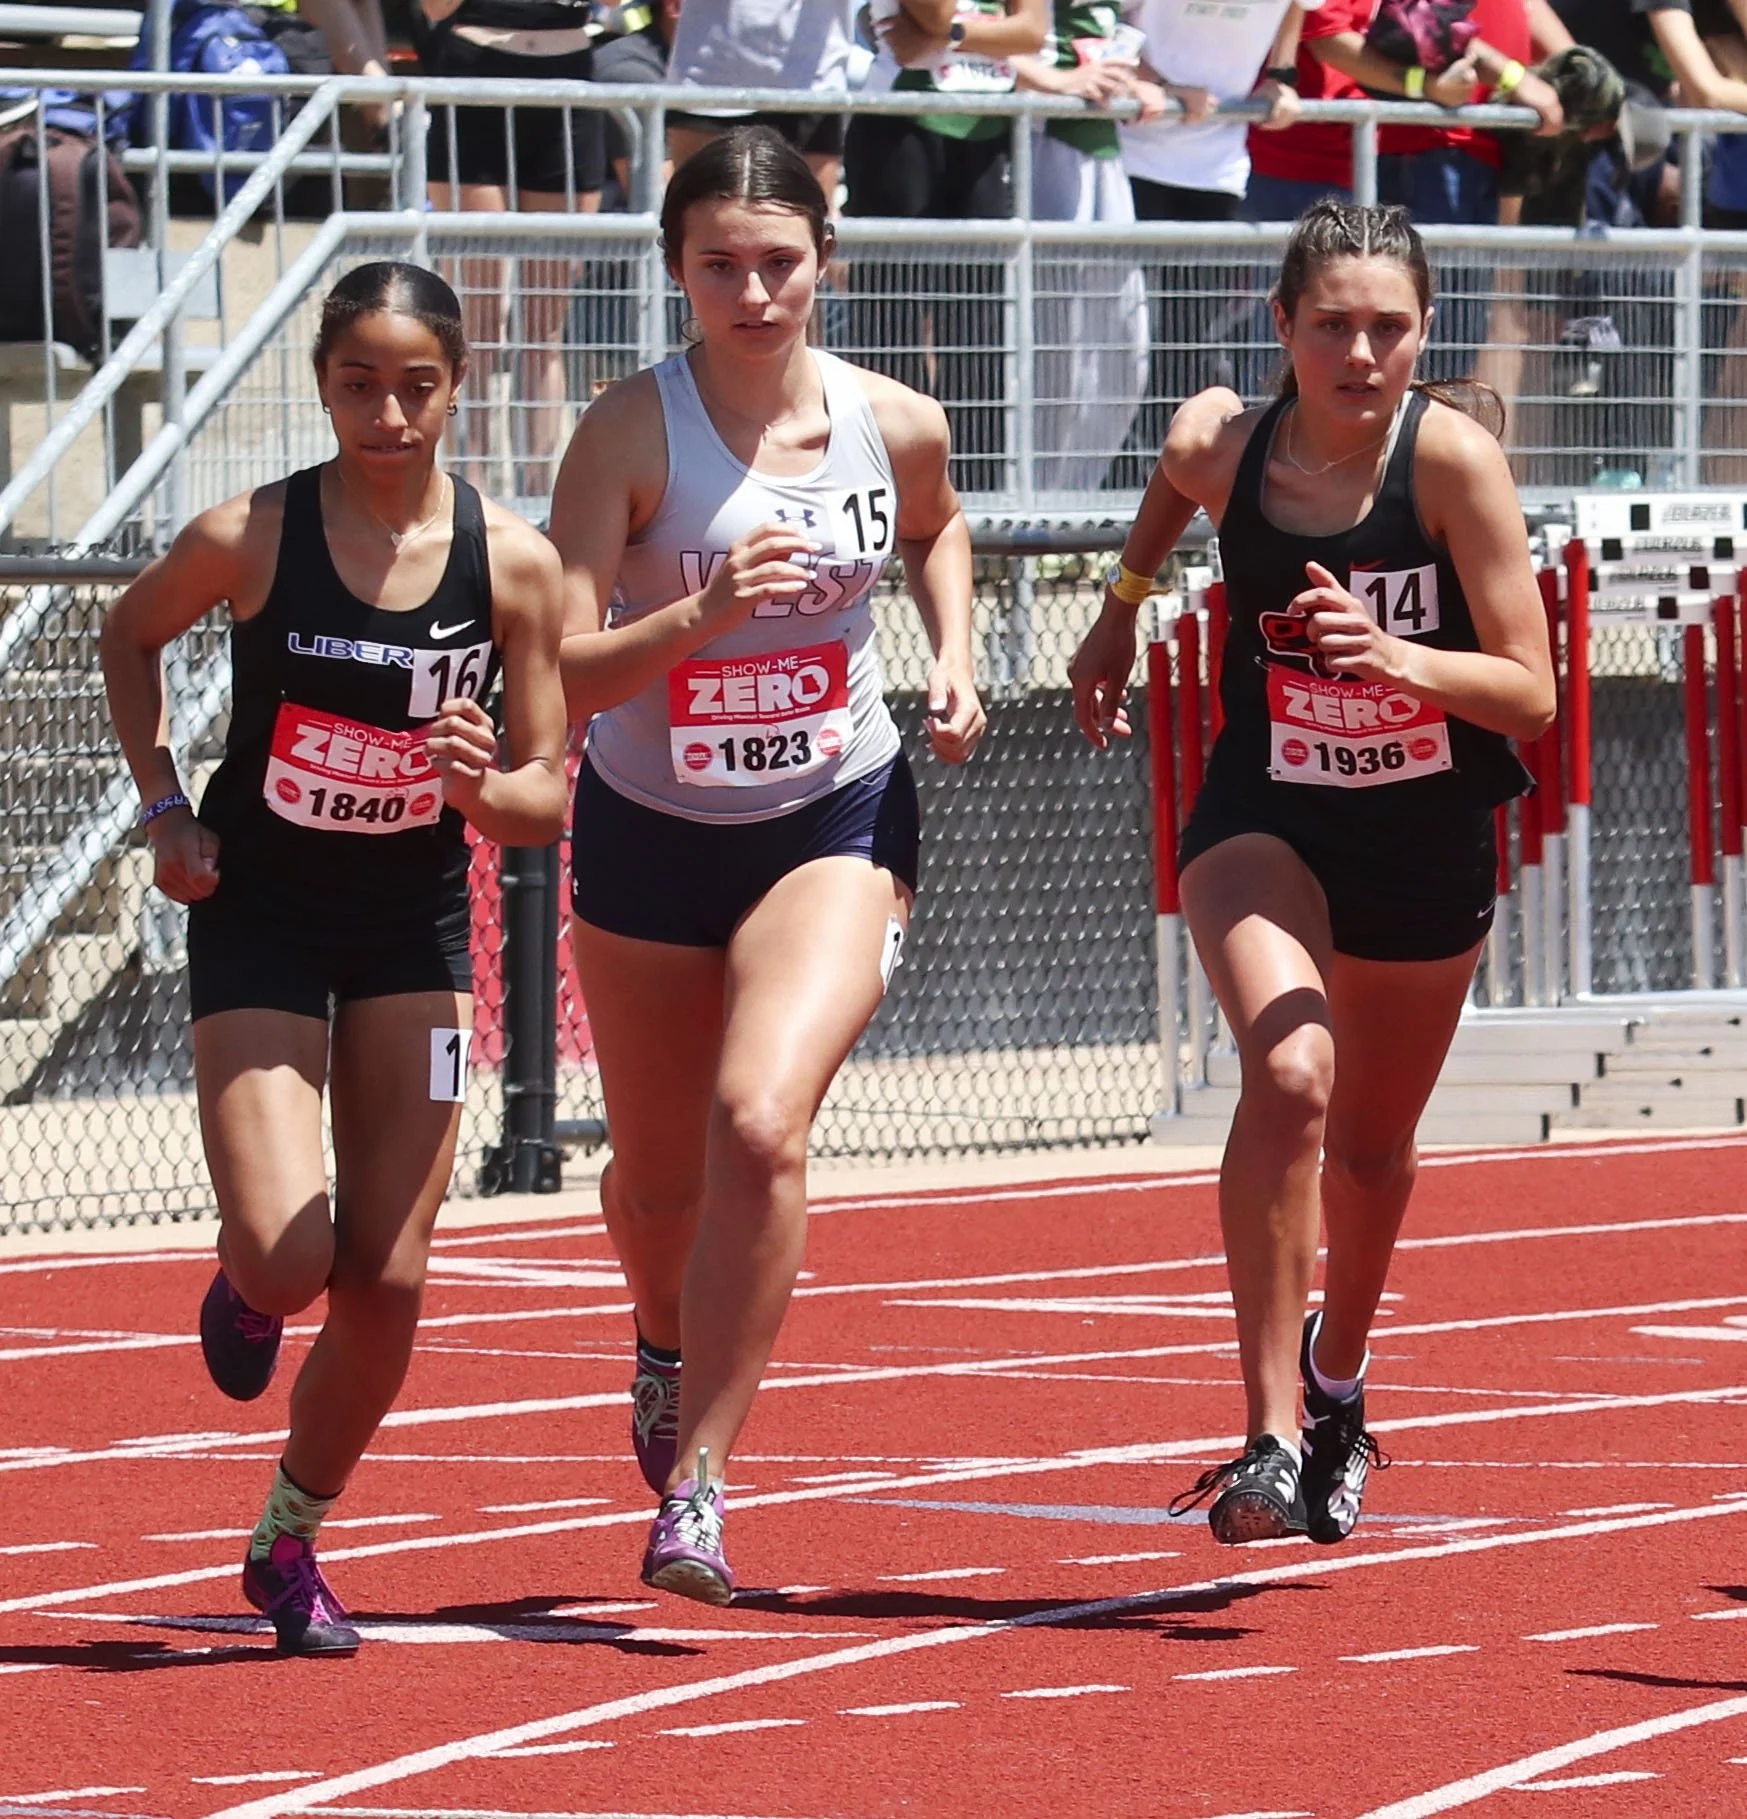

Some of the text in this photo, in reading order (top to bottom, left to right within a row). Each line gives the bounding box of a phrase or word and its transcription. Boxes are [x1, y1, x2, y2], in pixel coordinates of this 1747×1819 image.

[842, 488, 888, 553] 15
[1365, 573, 1426, 632] 14
[429, 648, 480, 712] 16
[722, 655, 799, 678] SHOW-ME
[688, 665, 830, 715] ZERO
[1282, 685, 1421, 730] ZERO
[1309, 682, 1384, 698] SHOW-ME
[290, 724, 432, 779] ZERO
[331, 722, 412, 749] SHOW-ME
[719, 730, 811, 771] 1823
[1314, 741, 1406, 776] 1936
[309, 788, 406, 823] 1840
[446, 1033, 468, 1096] 1
